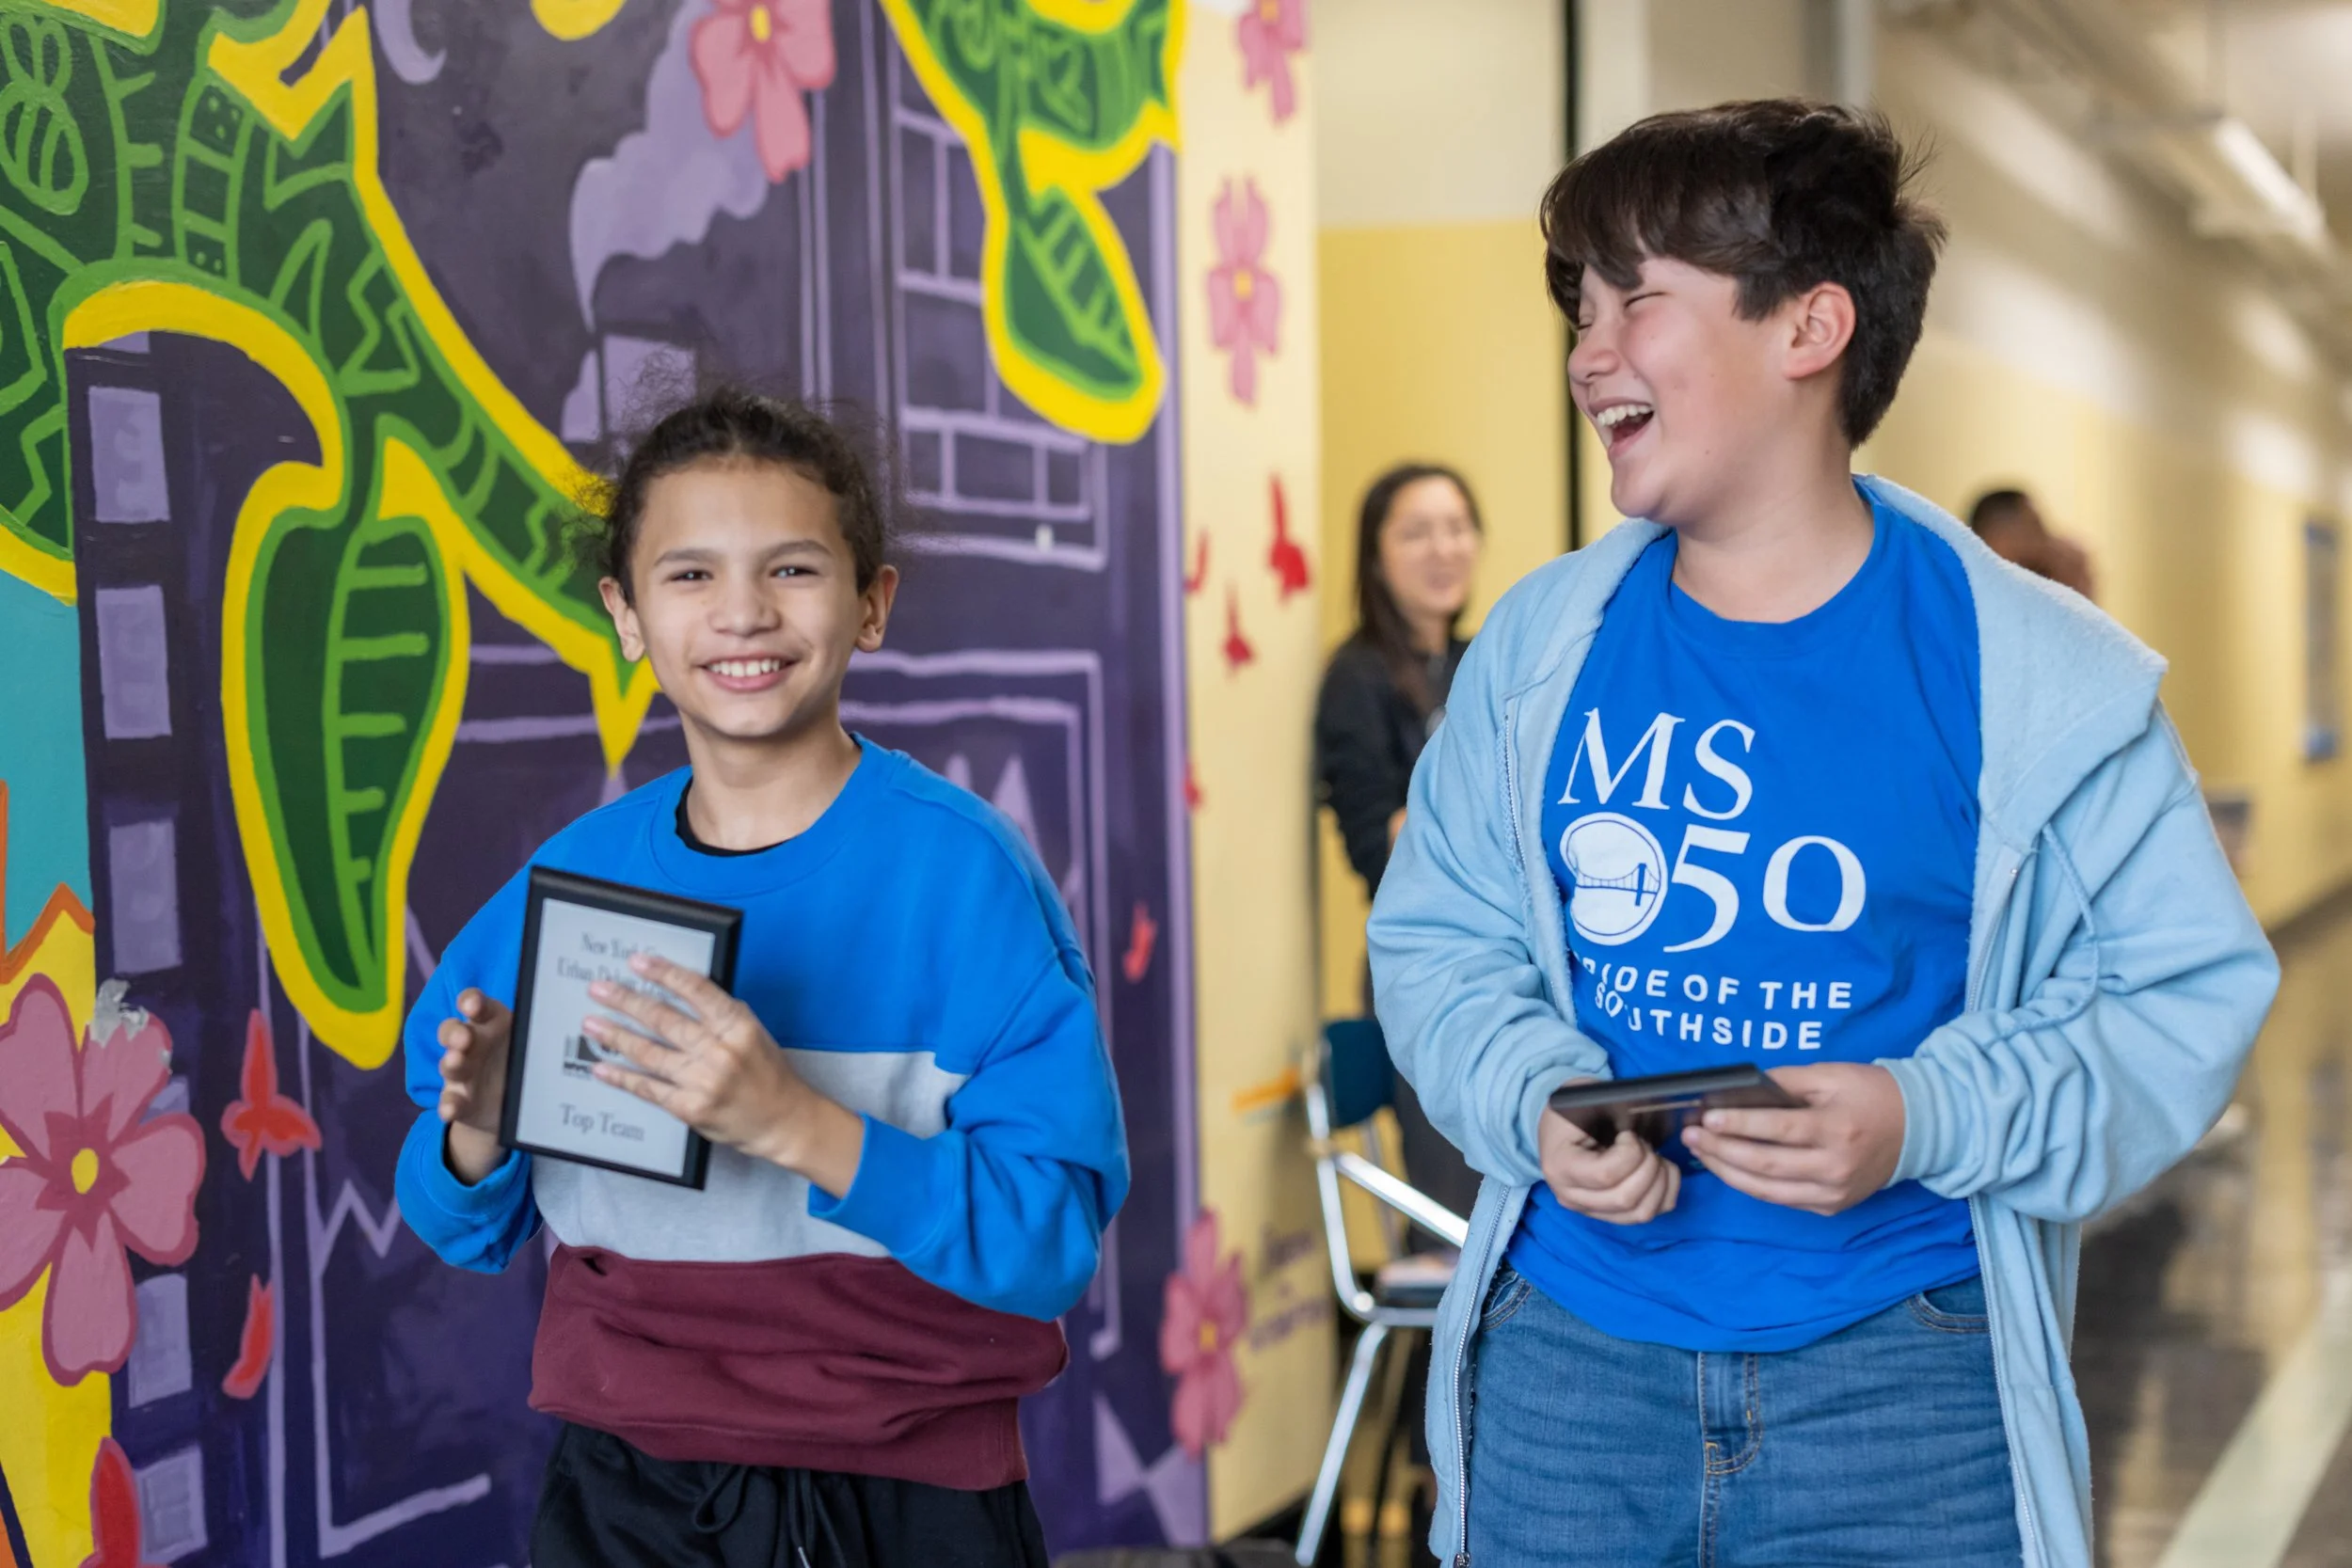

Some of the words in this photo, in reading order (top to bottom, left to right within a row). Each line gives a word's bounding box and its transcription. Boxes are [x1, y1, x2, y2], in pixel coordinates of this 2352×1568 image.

[1558, 707, 1756, 820] MS
[580, 931, 609, 955] New
[1682, 974, 1740, 1005] OF
[1758, 981, 1852, 1011] THE
[1594, 982, 1823, 1051] SOUTHSIDE
[559, 1102, 595, 1135] Top
[596, 1111, 645, 1142] Team
